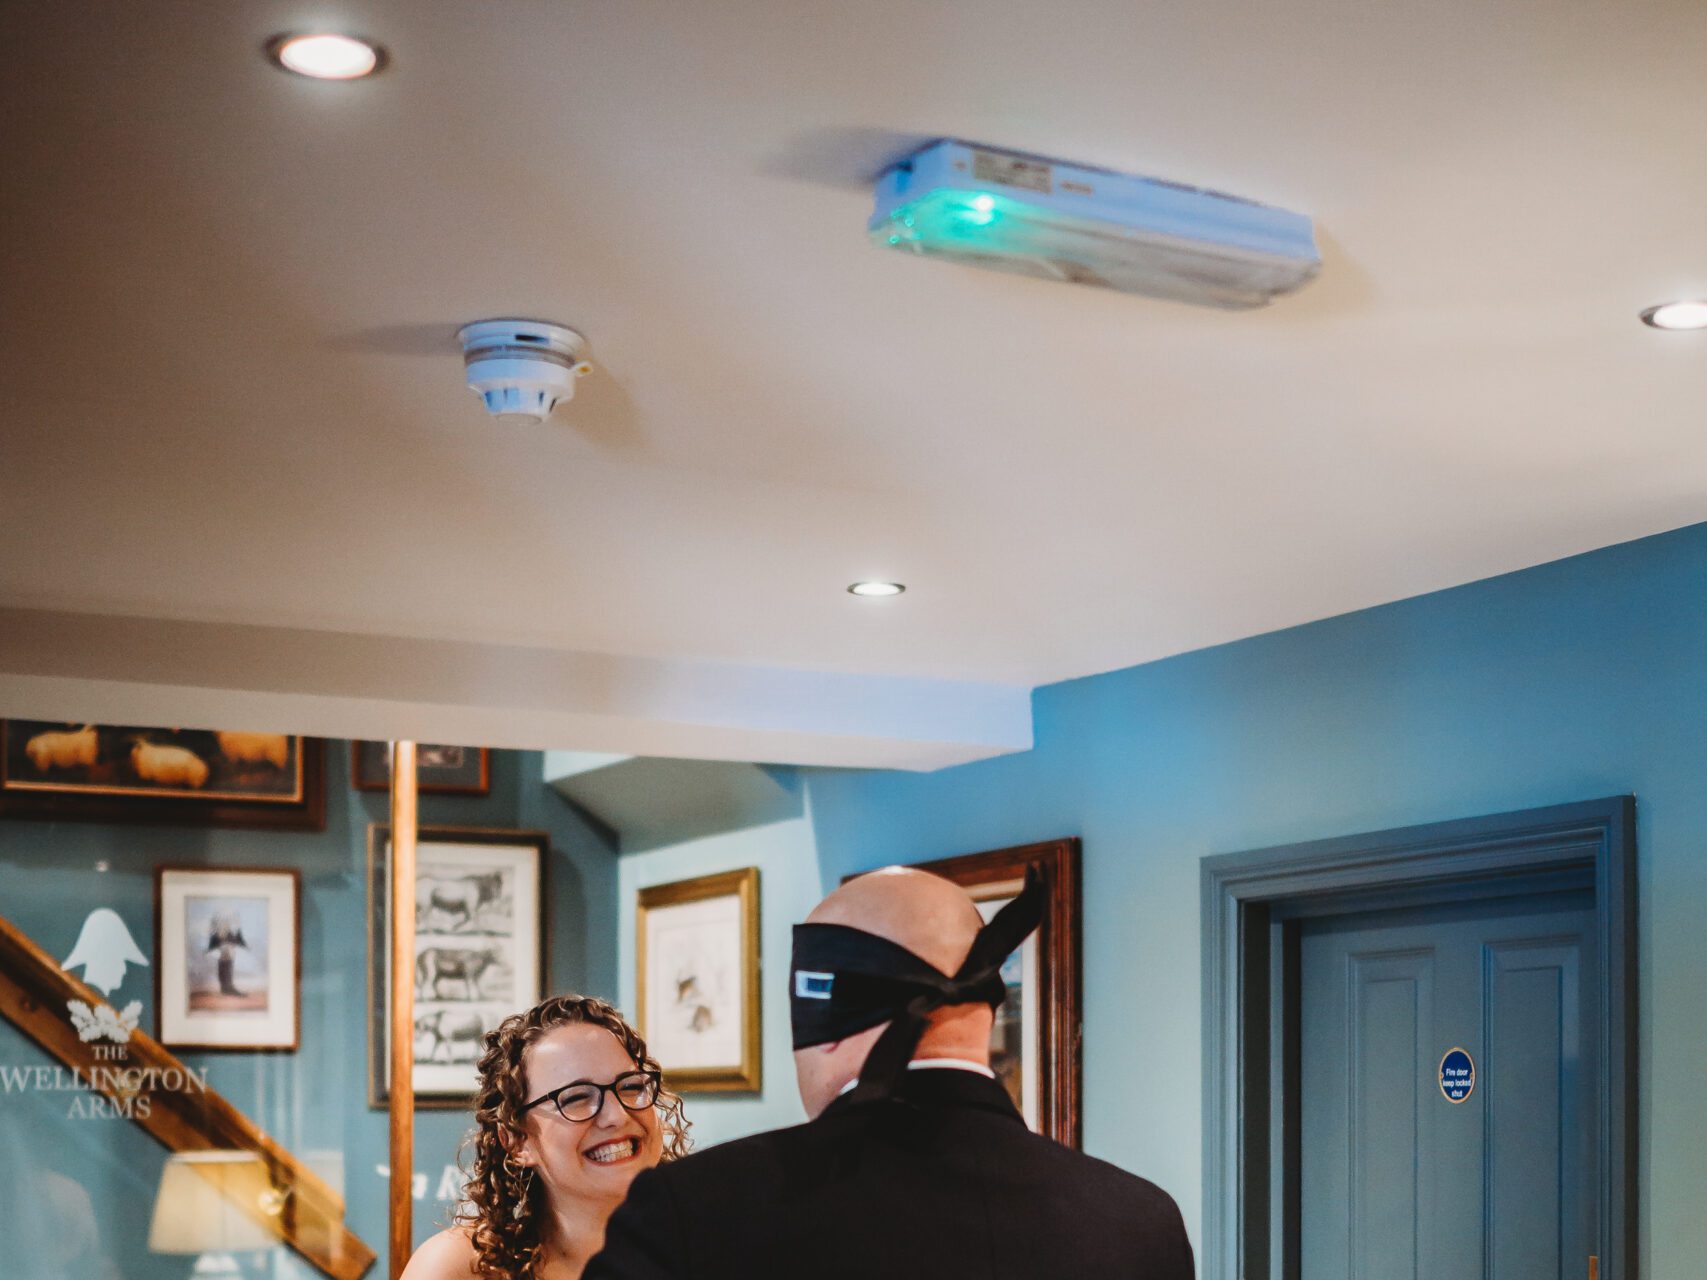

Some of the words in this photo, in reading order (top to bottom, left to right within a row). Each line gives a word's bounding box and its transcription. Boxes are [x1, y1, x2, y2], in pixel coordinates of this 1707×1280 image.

[92, 1045, 128, 1061] THE
[0, 1066, 208, 1094] WELLINGTON
[1456, 1068, 1468, 1076] door
[67, 1096, 152, 1120] ARMS
